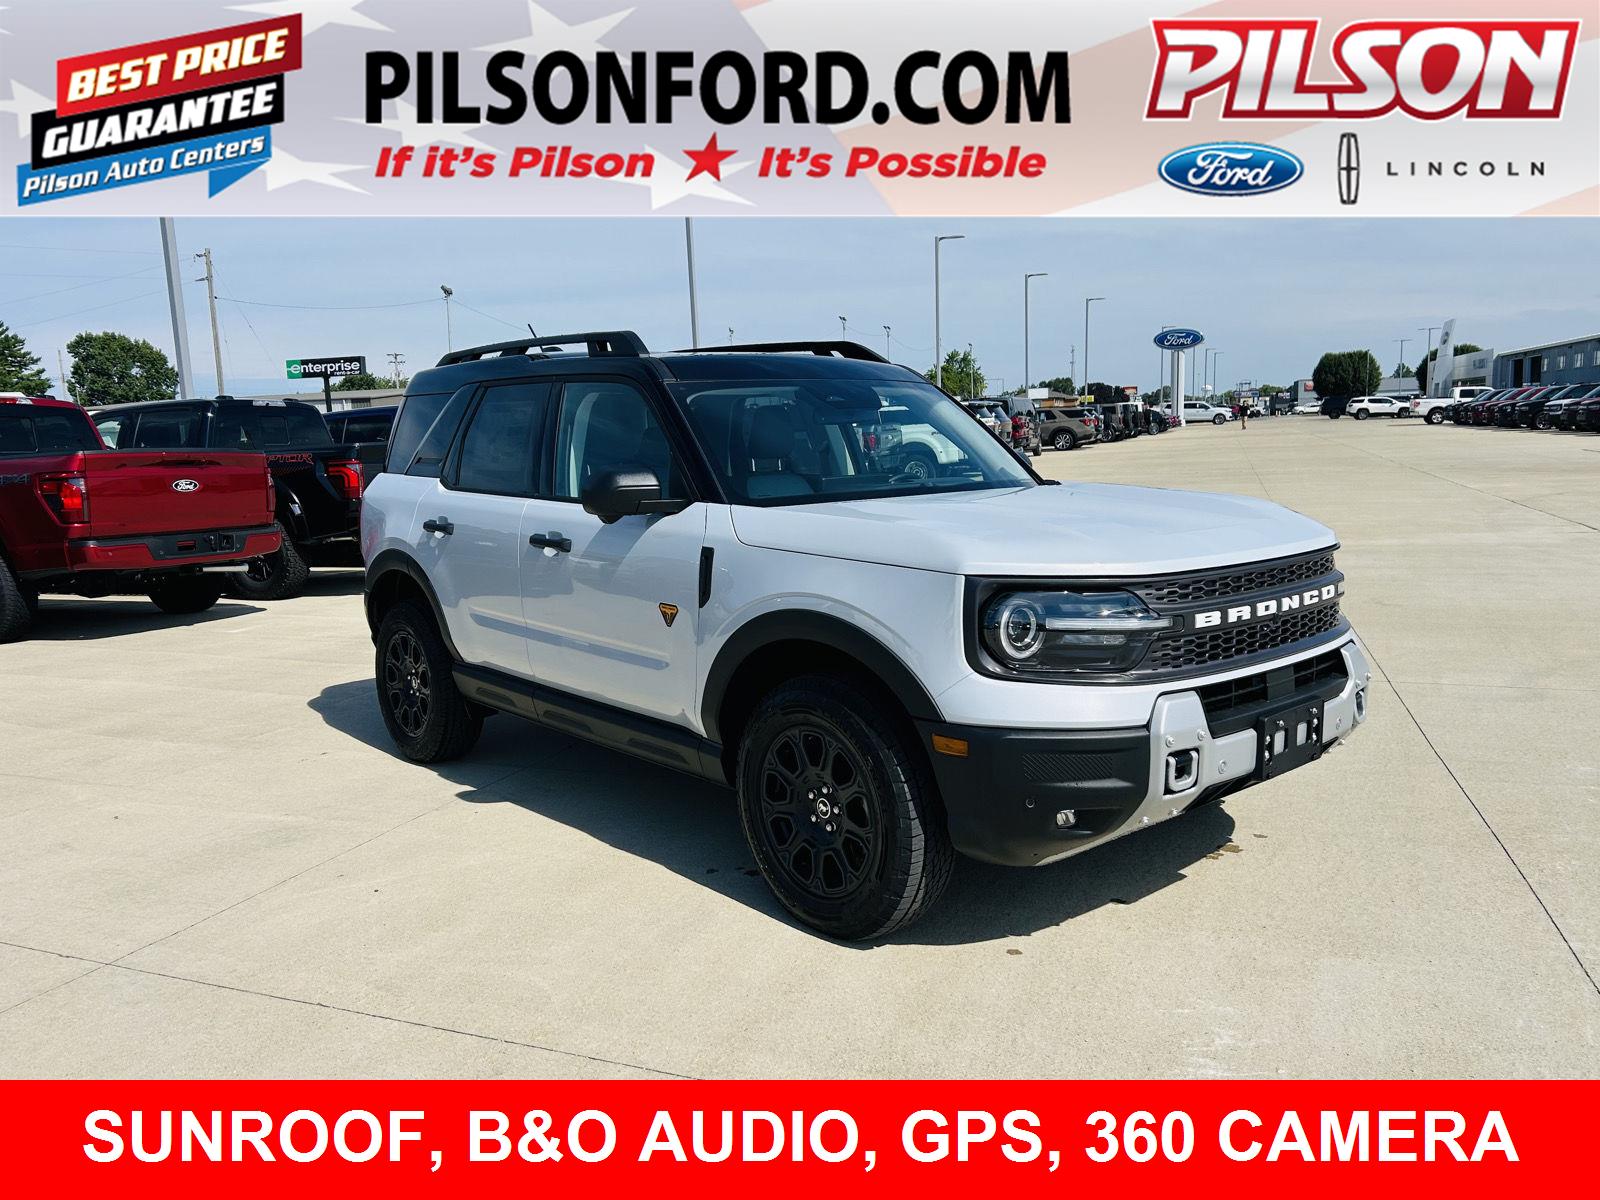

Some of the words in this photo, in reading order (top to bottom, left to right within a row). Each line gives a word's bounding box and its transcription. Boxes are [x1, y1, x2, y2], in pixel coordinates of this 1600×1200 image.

[1164, 332, 1193, 346] Ford
[290, 360, 360, 375] enterprise
[1194, 584, 1336, 629] BRONCO
